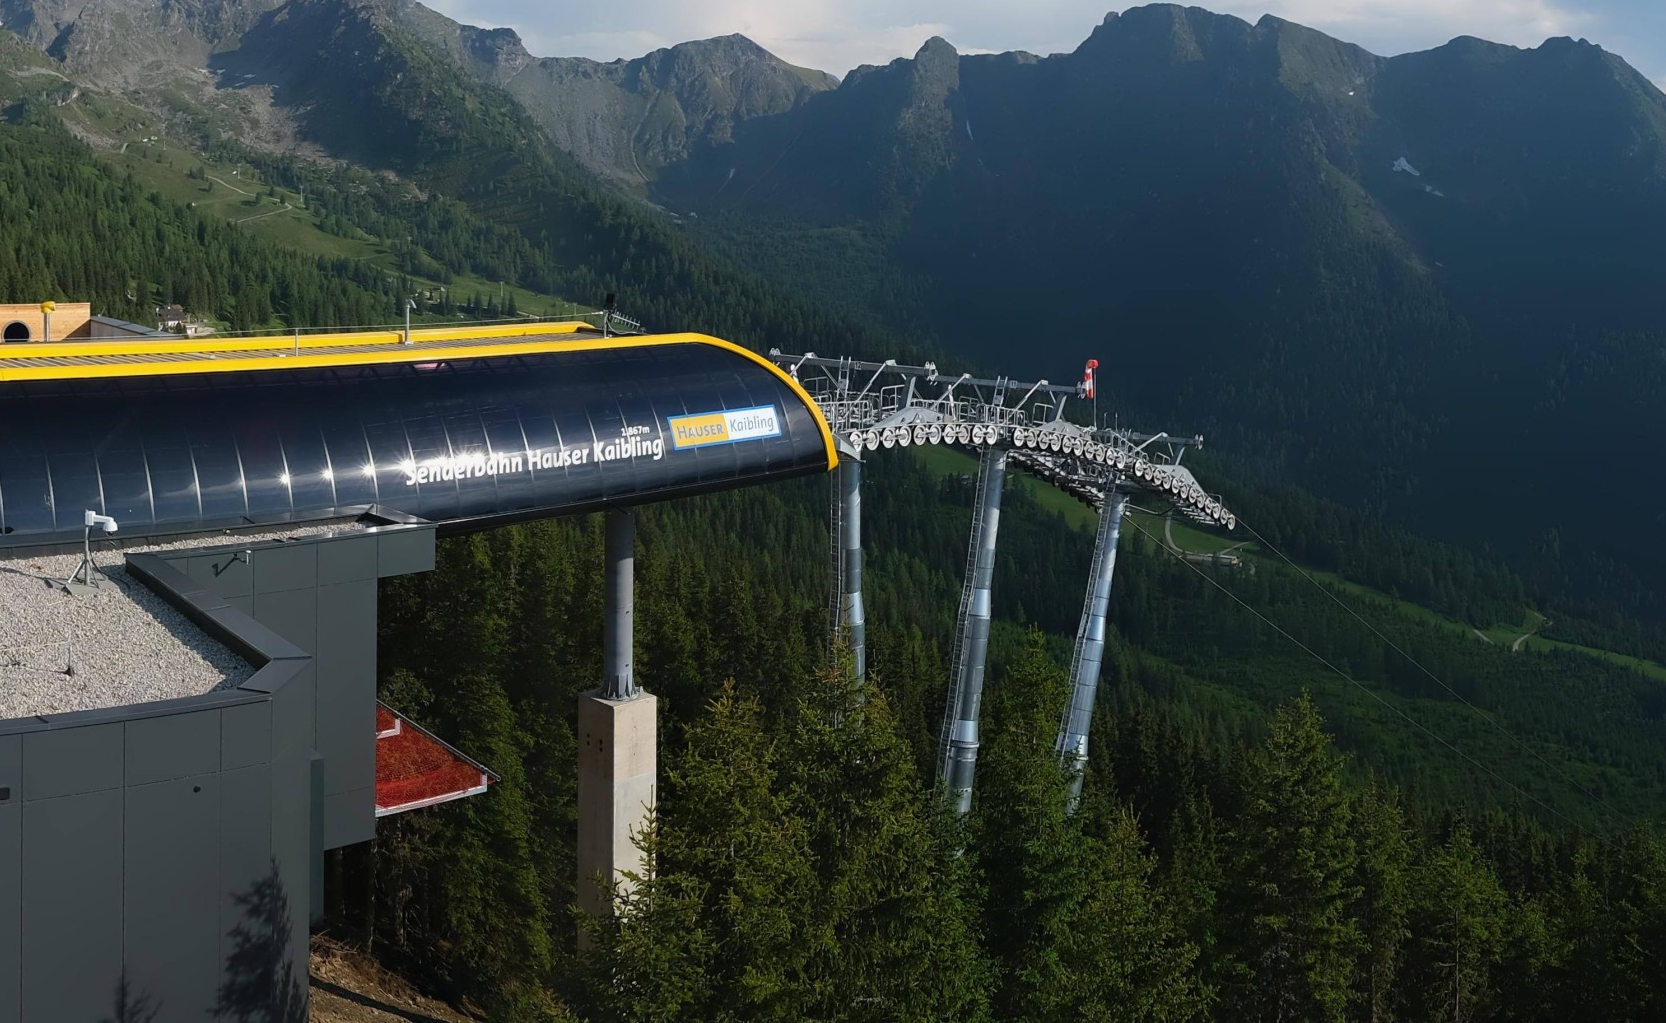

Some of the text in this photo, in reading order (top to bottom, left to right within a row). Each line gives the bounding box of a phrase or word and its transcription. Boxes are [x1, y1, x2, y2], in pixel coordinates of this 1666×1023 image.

[677, 414, 775, 440] HAUSER Kaibling
[406, 436, 663, 486] Senderbahn Hauser Kaibling
